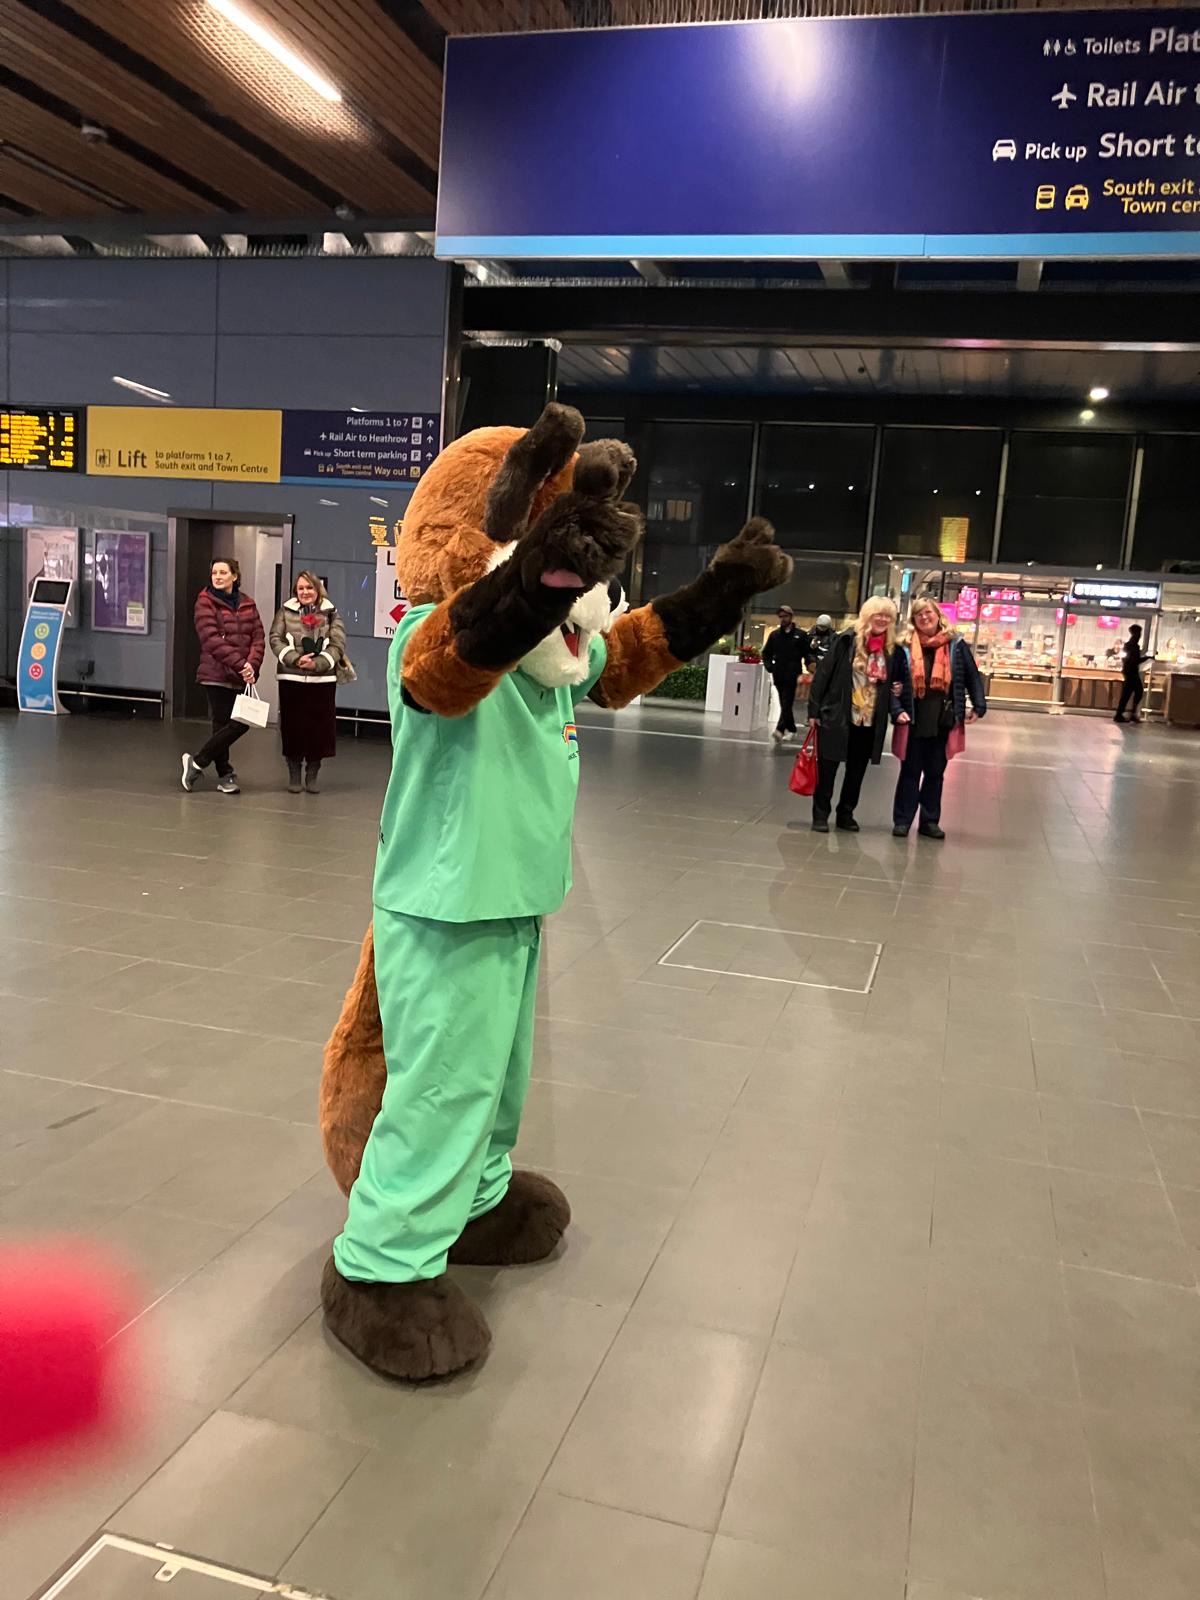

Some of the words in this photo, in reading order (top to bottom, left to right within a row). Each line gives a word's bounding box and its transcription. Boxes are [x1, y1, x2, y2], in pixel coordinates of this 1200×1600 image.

[1084, 37, 1141, 55] Toilets
[1087, 81, 1137, 107] Rail
[1144, 80, 1187, 106] Air
[1025, 143, 1060, 160] Pick
[1065, 146, 1087, 162] up
[1099, 132, 1175, 157] Short
[1103, 178, 1155, 196] South
[1160, 178, 1194, 195] exit
[1121, 198, 1166, 213] Town
[346, 416, 384, 426] Platforms
[386, 418, 391, 427] 1
[393, 418, 401, 427] to
[403, 418, 409, 427] 7
[329, 432, 344, 442] Rail
[345, 433, 357, 442] Air
[358, 434, 368, 442] to
[369, 434, 408, 443] Heathrow
[118, 449, 148, 468] Lift
[155, 450, 164, 459] to
[166, 451, 205, 461] platforms
[208, 452, 213, 460] 1
[215, 452, 224, 461] to
[333, 448, 355, 458] Short
[357, 450, 376, 459] term
[377, 450, 408, 462] parking
[155, 460, 178, 470] South
[181, 462, 196, 471] exit
[198, 463, 213, 471] and
[217, 463, 239, 473] Town
[241, 464, 268, 473] Centre
[374, 466, 391, 477] Way
[392, 468, 407, 476] out
